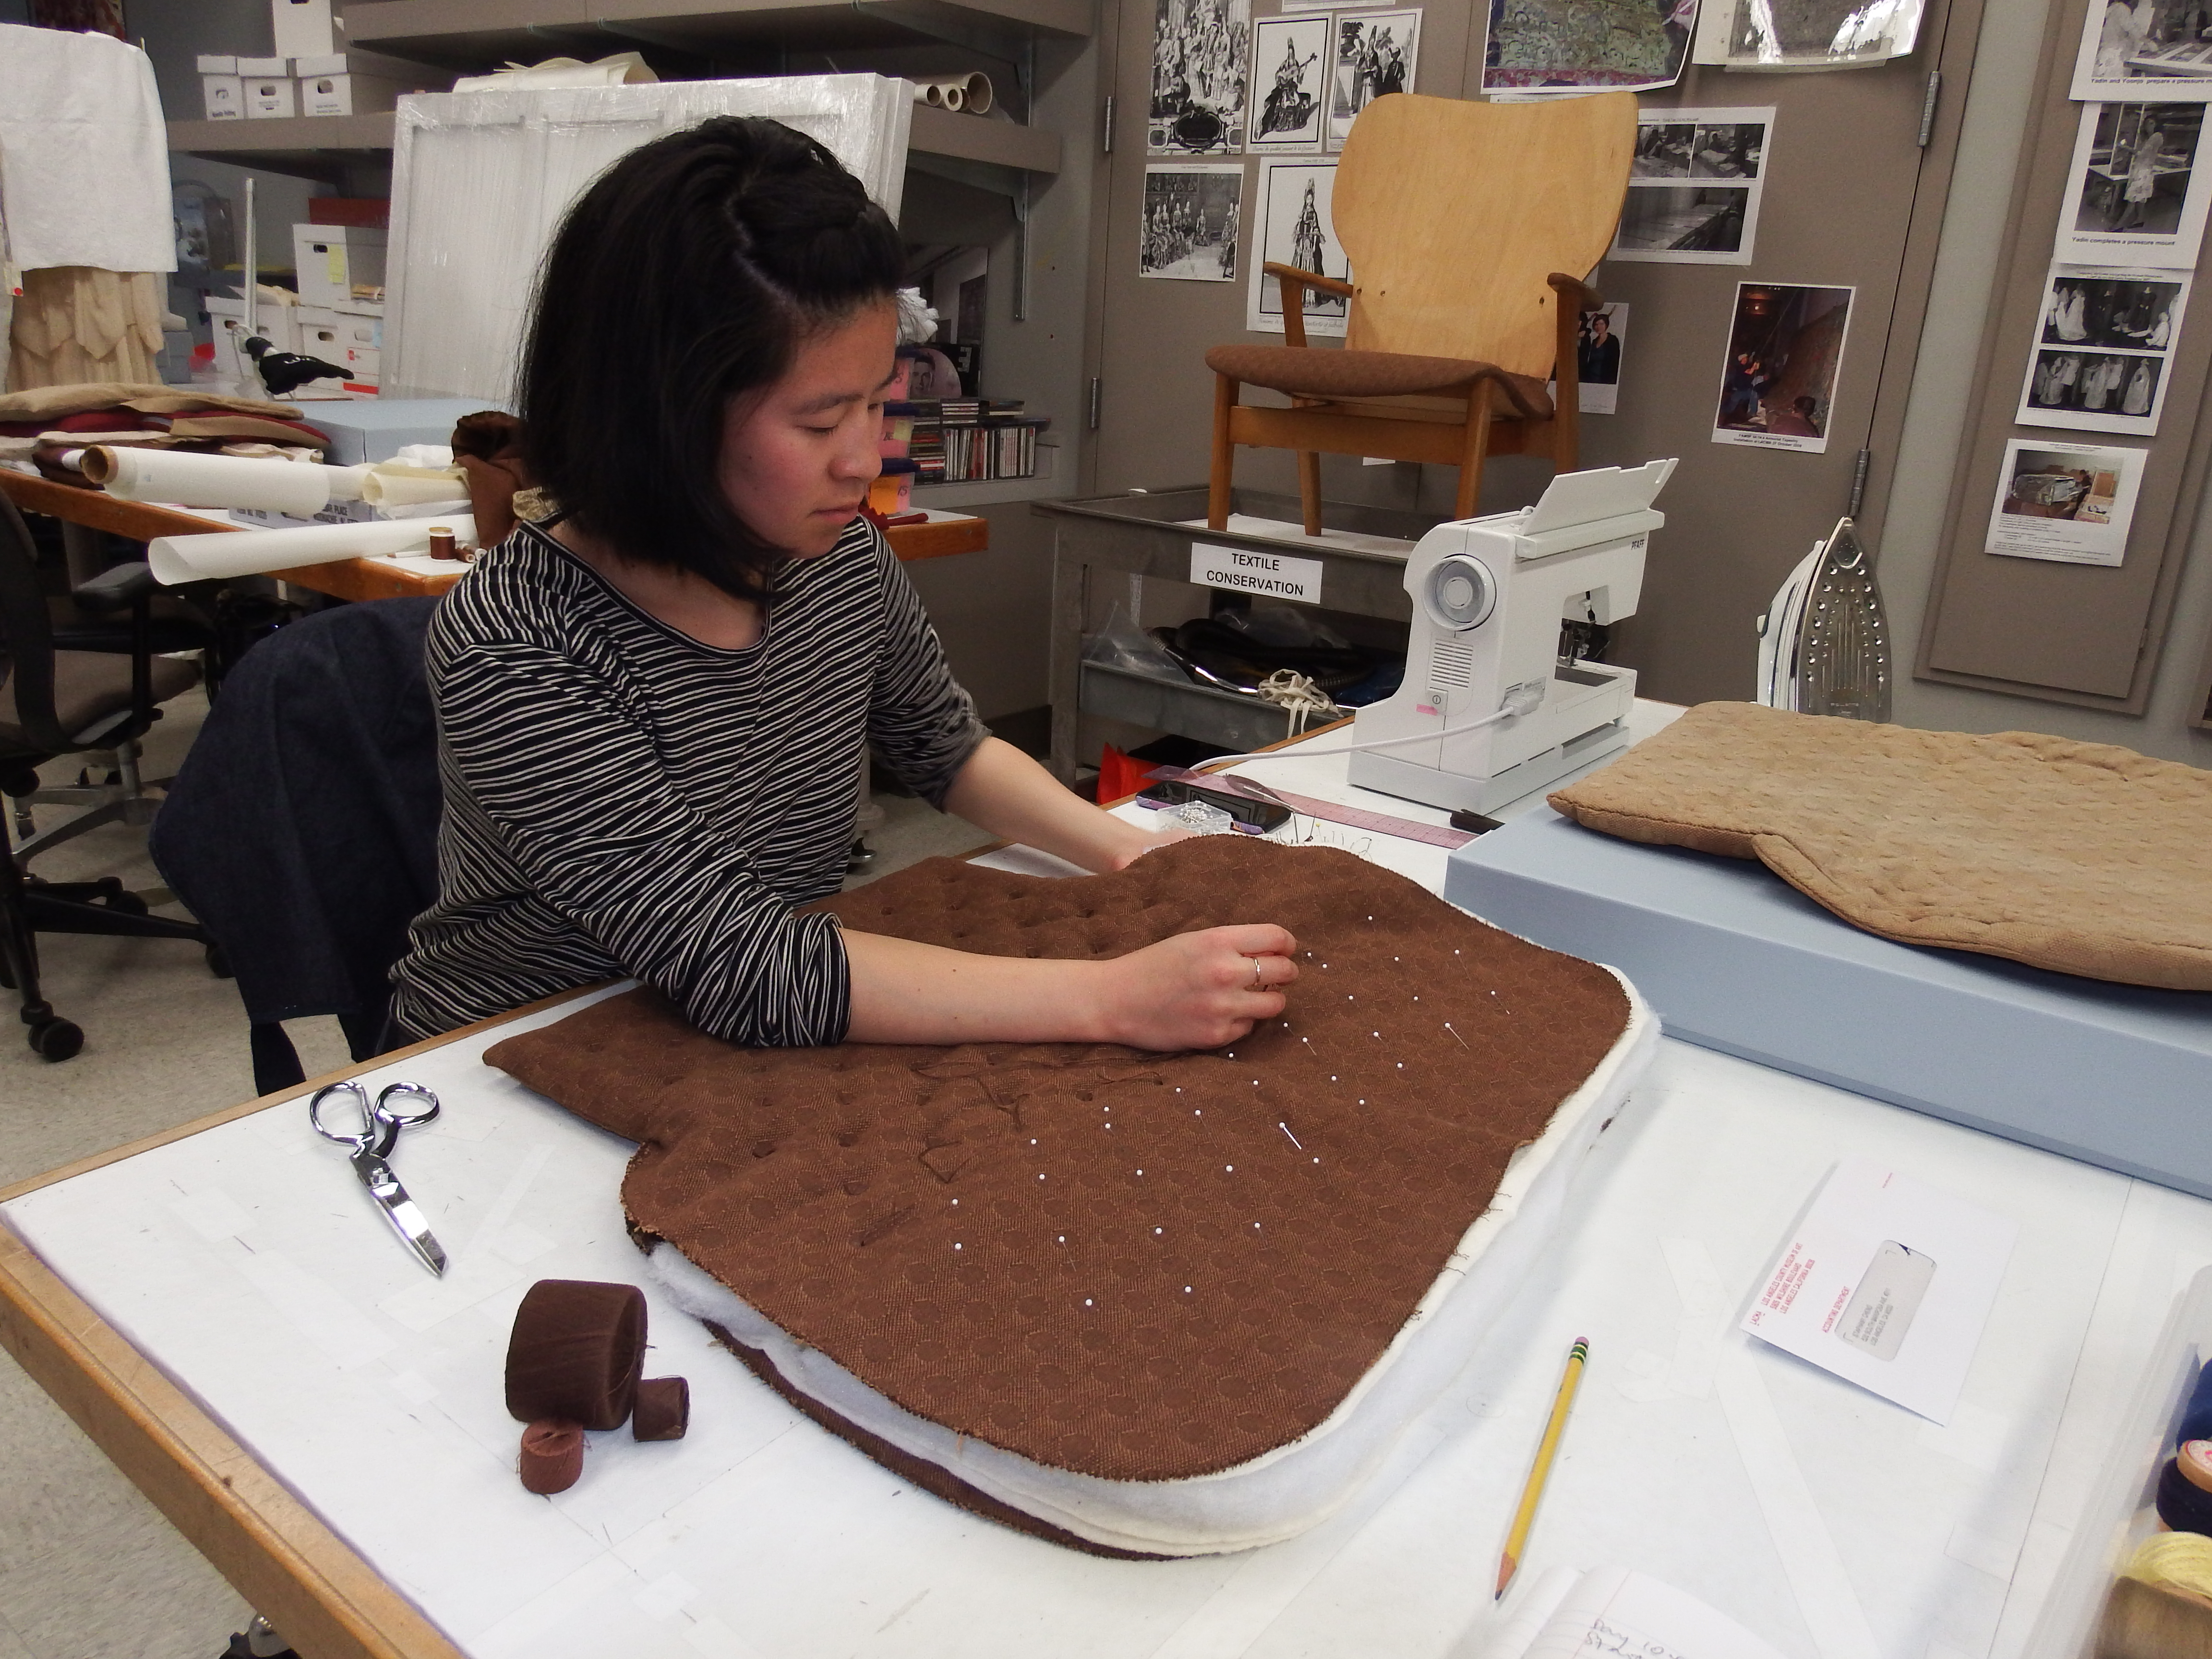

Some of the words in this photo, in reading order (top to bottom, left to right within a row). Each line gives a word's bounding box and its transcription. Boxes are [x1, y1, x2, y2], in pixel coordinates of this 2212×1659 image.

[1232, 553, 1280, 571] TEXTILE
[1207, 570, 1303, 596] CONSERVATION
[1766, 1280, 1779, 1298] ANGELES
[1784, 1288, 1798, 1306] ANGELES
[1794, 1269, 1809, 1289] CALIFORNIA
[1822, 1309, 1838, 1333] ACCOUNTING
[1834, 1286, 1850, 1310] DEPARTMENT
